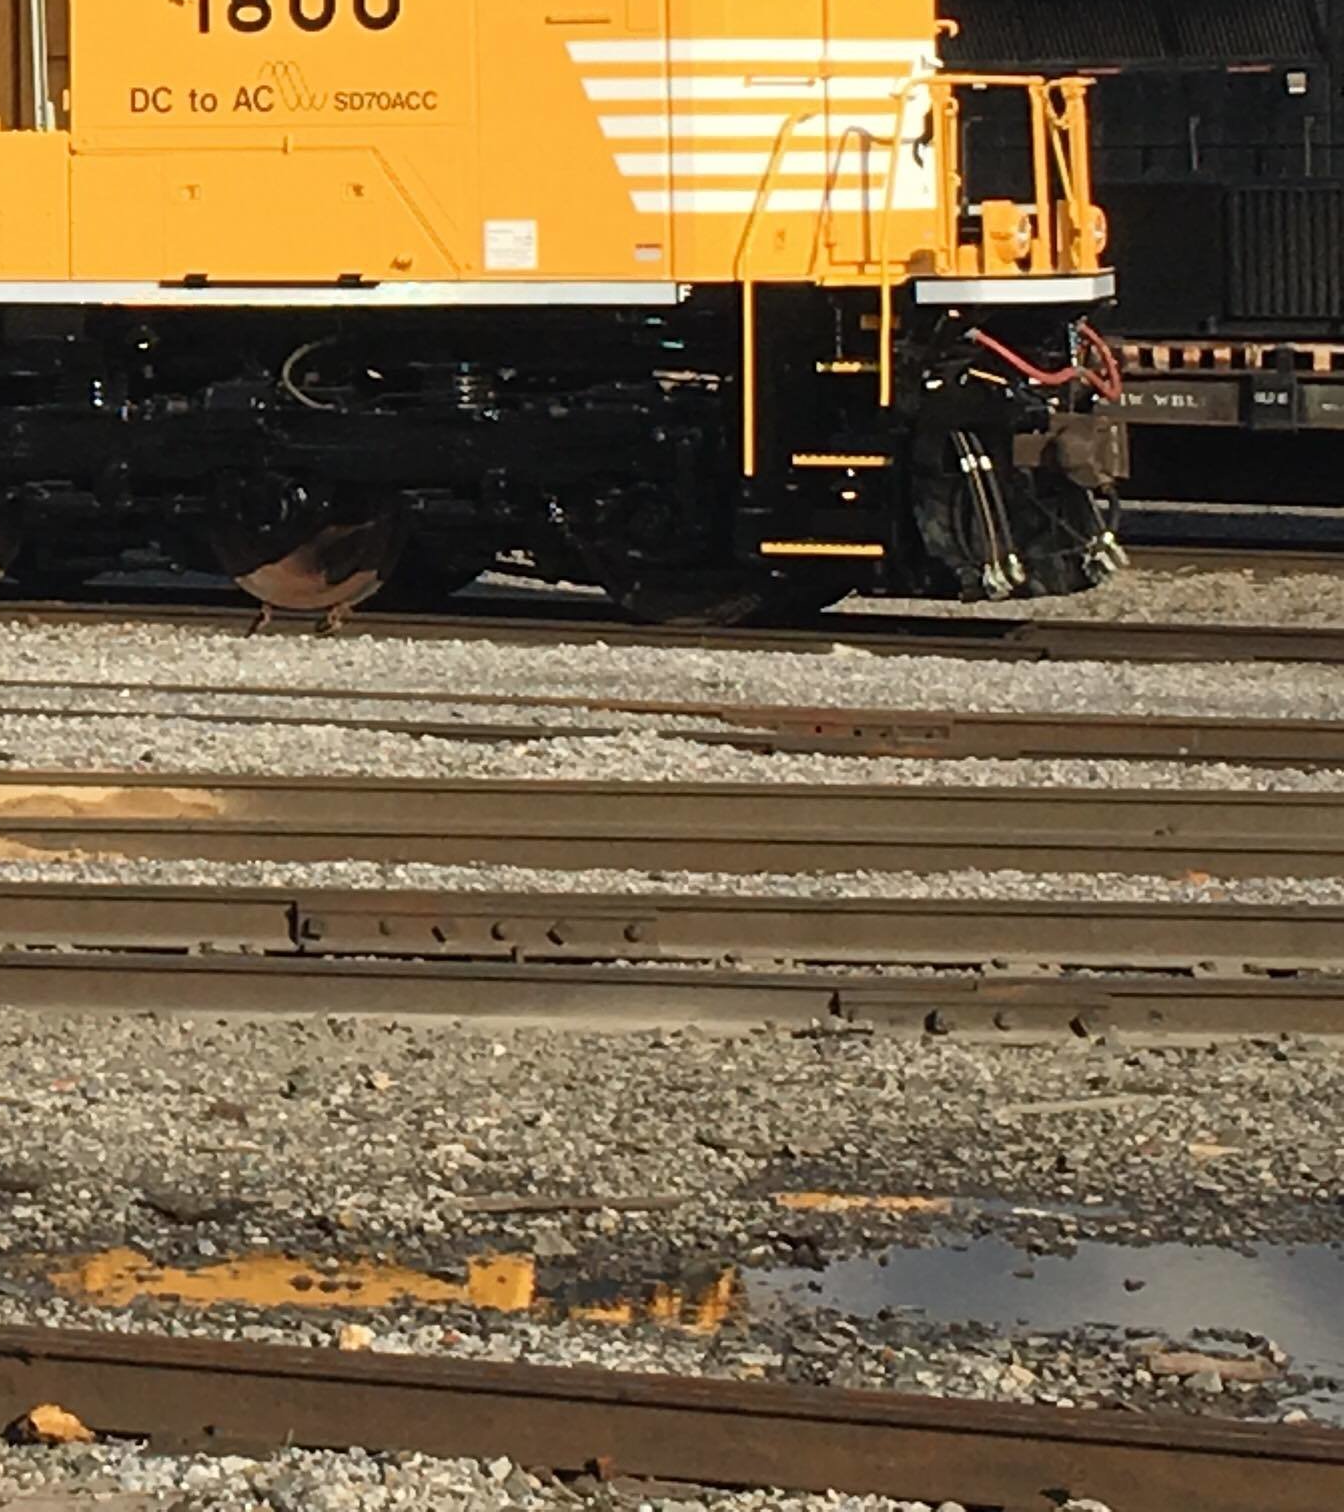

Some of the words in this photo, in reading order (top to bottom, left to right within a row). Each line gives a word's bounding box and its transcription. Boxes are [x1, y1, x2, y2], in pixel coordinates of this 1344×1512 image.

[129, 86, 173, 113] DC
[189, 88, 218, 113] to
[232, 84, 276, 113] AC
[332, 89, 439, 111] SD70ACC
[678, 283, 694, 303] F
